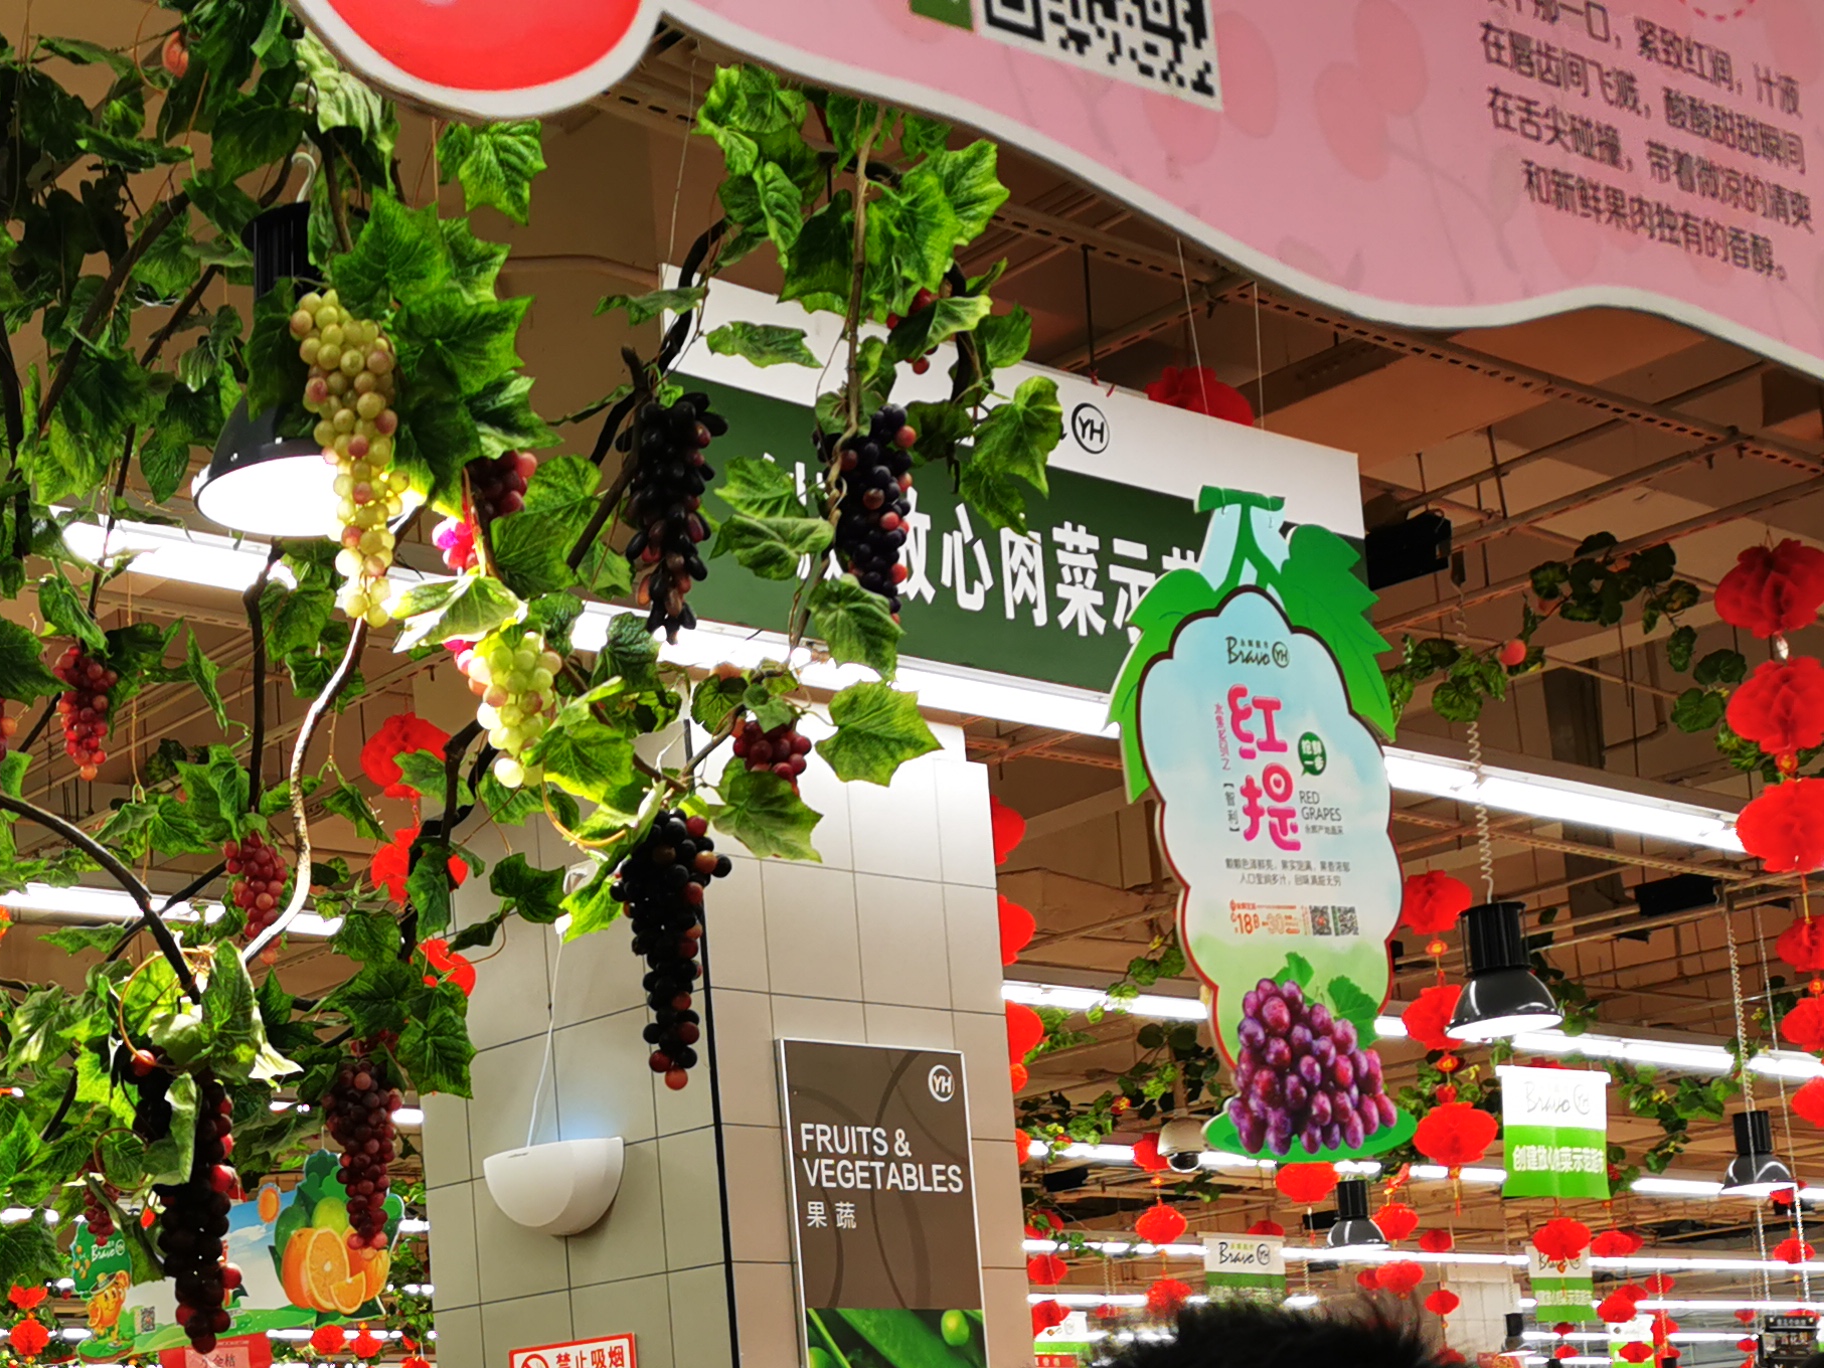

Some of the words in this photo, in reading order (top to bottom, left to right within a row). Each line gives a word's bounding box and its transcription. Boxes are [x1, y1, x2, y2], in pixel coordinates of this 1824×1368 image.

[1226, 636, 1271, 665] Bravo
[1227, 684, 1301, 851] 红提
[1299, 790, 1320, 804] RED
[1301, 807, 1342, 821] GRAPES
[800, 1123, 889, 1156] FRUITS
[893, 1129, 912, 1157] &
[802, 1157, 964, 1194] VEGETABLES
[805, 1201, 858, 1230] 果蔬
[1218, 1242, 1255, 1264] Bravo
